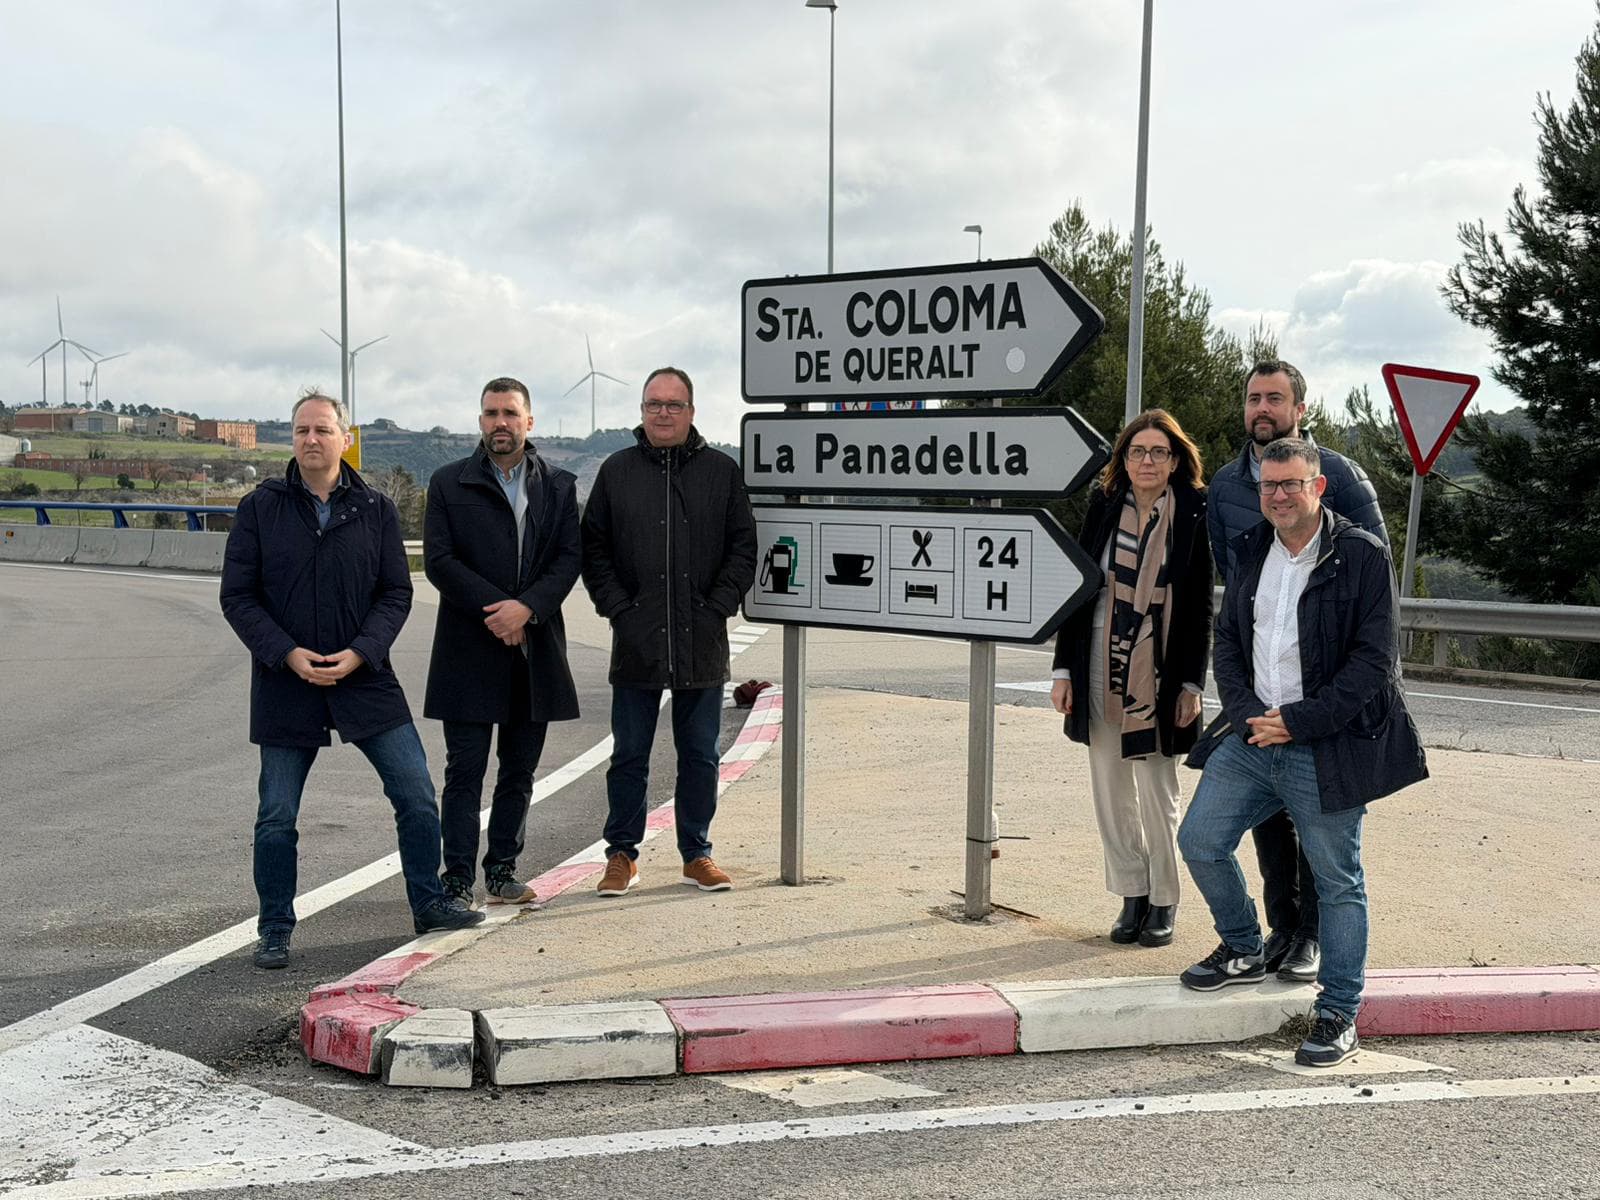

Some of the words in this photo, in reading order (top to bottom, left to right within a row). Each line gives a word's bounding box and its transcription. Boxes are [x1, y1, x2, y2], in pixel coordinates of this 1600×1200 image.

[846, 281, 1027, 338] COLOMA
[795, 350, 831, 384] DE
[843, 343, 980, 384] QUERALT
[753, 433, 795, 474] La
[815, 431, 1029, 476] Panadella
[977, 535, 1019, 569] 24
[986, 580, 1008, 611] H
